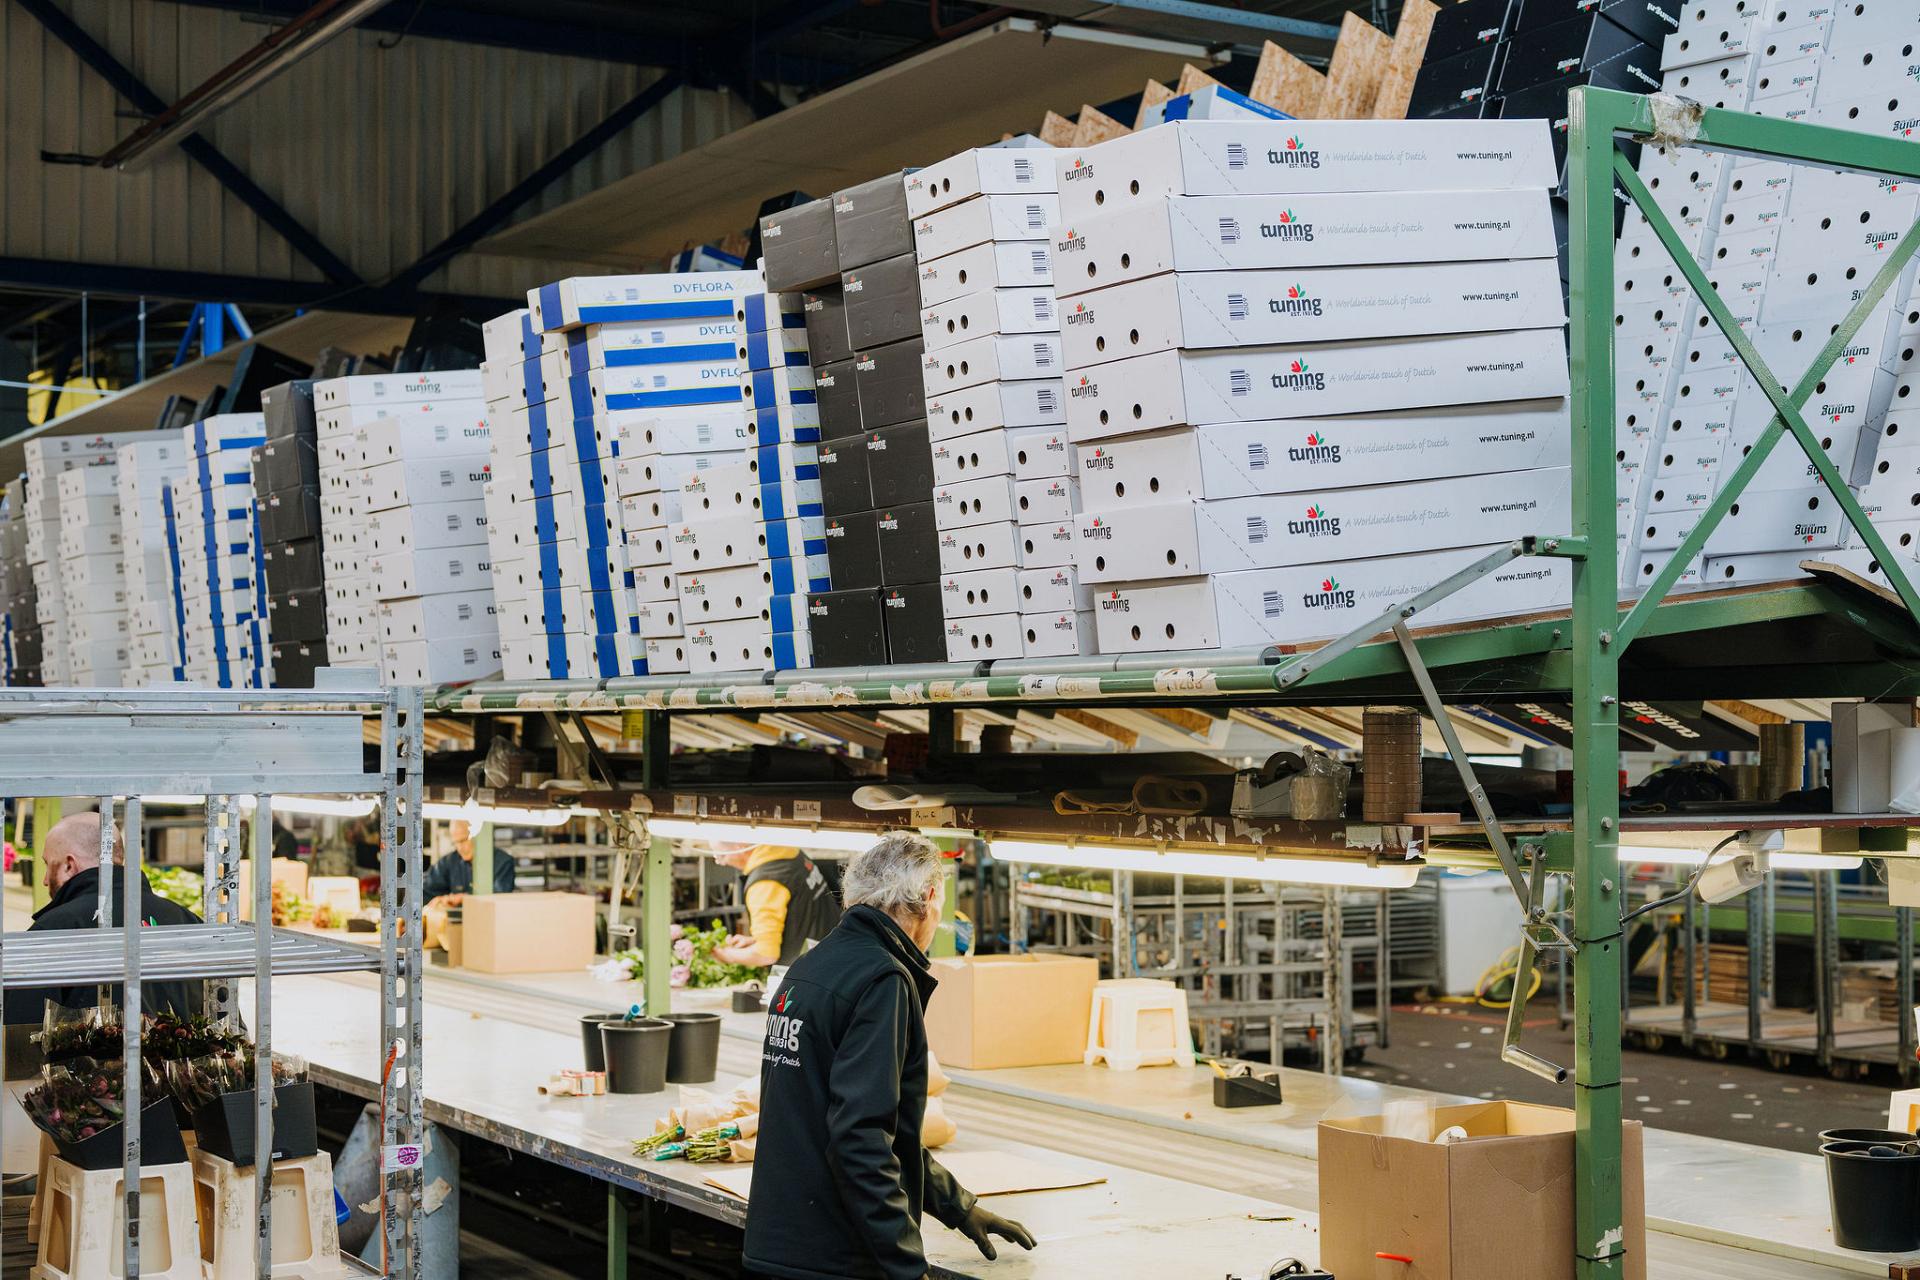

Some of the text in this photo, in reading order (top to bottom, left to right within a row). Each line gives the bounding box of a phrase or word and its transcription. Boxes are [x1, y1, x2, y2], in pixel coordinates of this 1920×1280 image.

[1267, 148, 1320, 169] tuning
[1457, 151, 1512, 161] www.tuning.nl
[1065, 163, 1094, 181] tuning
[1260, 221, 1313, 242] tuning
[1454, 220, 1511, 231] www.tuning.nl
[1058, 234, 1086, 252] tuning
[1865, 231, 1898, 244] tuning
[674, 282, 734, 293] DVFLORA
[1462, 292, 1519, 302] www.tuning.nl
[1269, 296, 1322, 316] tuning
[1067, 309, 1094, 326] tuning
[1466, 361, 1524, 372] www.tuning.nl
[1271, 370, 1325, 391] tuning
[1338, 372, 1380, 382] Worldwide
[1381, 370, 1404, 380] touch
[1413, 368, 1436, 378] Dutch
[405, 383, 440, 393] tuning
[1071, 381, 1098, 400] tuning
[1821, 404, 1854, 416] tuning
[1478, 431, 1535, 444] www.tuning.nl
[1354, 444, 1394, 454] Worldwide
[1396, 442, 1418, 451] touch
[1427, 438, 1450, 450] Dutch
[1288, 443, 1341, 464] tuning
[1086, 455, 1114, 470] tuning
[685, 482, 706, 494] tuning
[1480, 501, 1537, 514] www.tuning.nl
[1354, 516, 1394, 527] Worldwide
[1396, 514, 1418, 524] touch
[1427, 511, 1451, 522] Dutch
[1288, 516, 1340, 536] tuning
[1794, 524, 1827, 536] tuning
[675, 532, 696, 544] tuning
[1083, 526, 1112, 540] tuning
[1495, 569, 1552, 582] www.tuning.nl
[684, 584, 706, 595] tuning
[1368, 588, 1407, 598] Worldwide
[1102, 598, 1130, 612] tuning
[1302, 589, 1355, 610] tuning
[692, 634, 713, 646] tuning
[1032, 680, 1043, 689] AE
